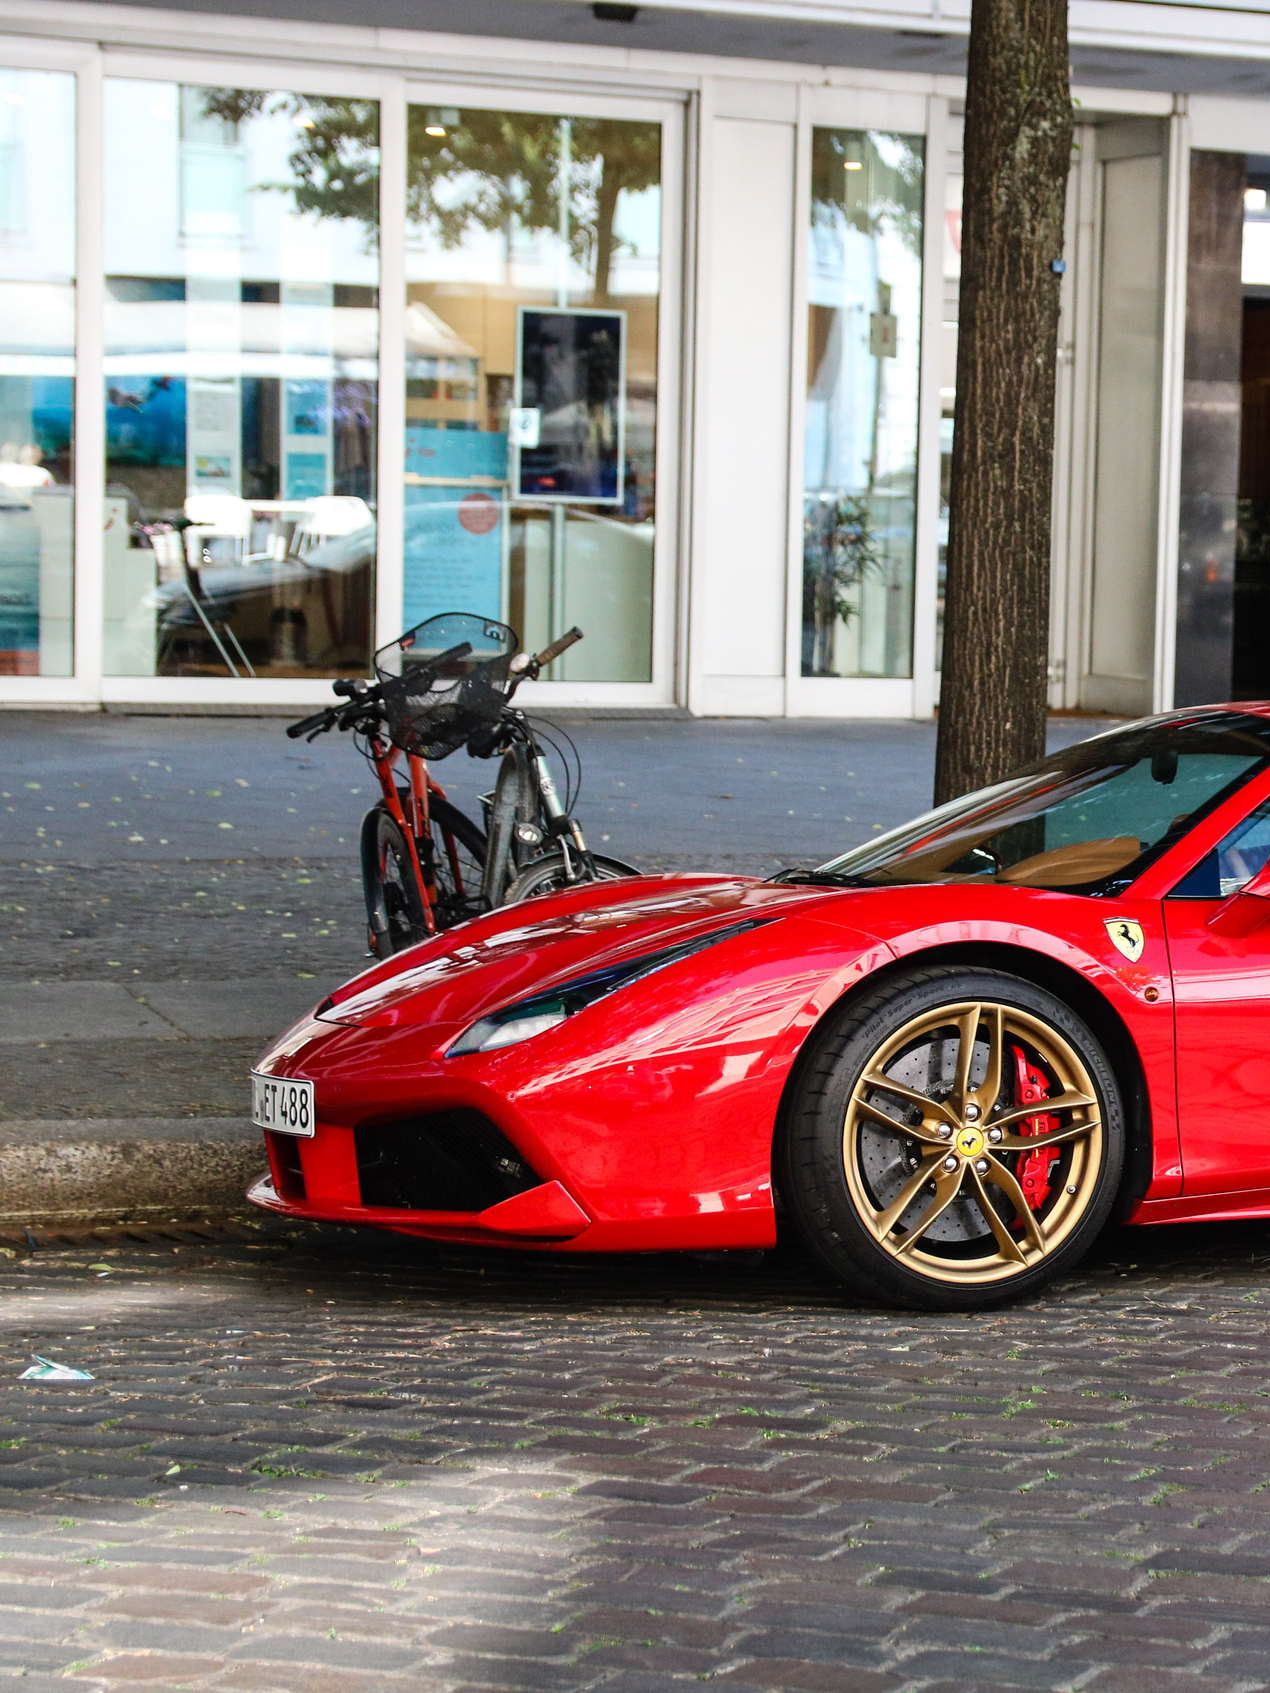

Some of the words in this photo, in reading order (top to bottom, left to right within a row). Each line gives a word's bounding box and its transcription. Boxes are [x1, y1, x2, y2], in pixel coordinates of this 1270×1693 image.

[917, 985, 944, 999] Sport
[1082, 1039, 1116, 1102] MICHELIN
[264, 1083, 278, 1123] ET
[280, 1085, 309, 1129] 488
